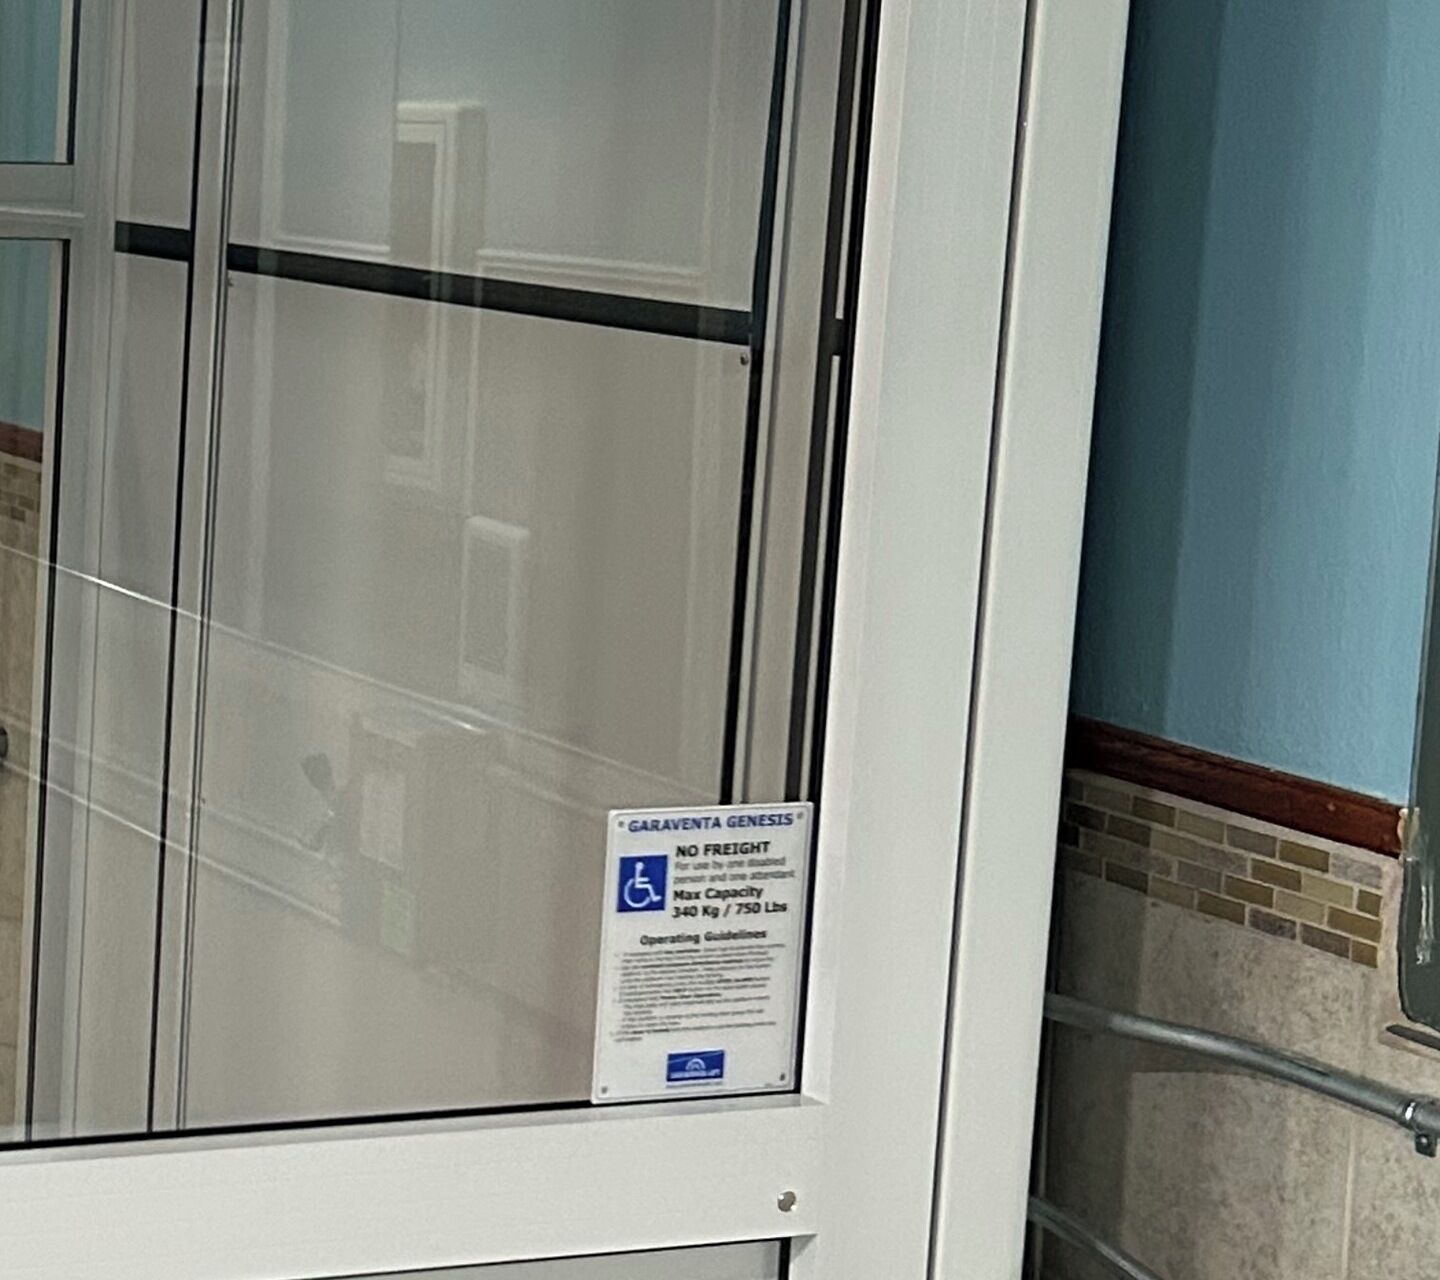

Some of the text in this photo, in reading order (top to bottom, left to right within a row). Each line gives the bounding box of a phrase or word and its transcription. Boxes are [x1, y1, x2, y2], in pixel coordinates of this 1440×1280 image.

[628, 813, 794, 833] GARAVENTA GENESIS
[676, 841, 771, 858] NO FREIGHT
[673, 886, 764, 902] Max Capacity
[672, 901, 788, 919] 340 Kg / 750 Lbs
[640, 929, 767, 947] Operating Guidelines
